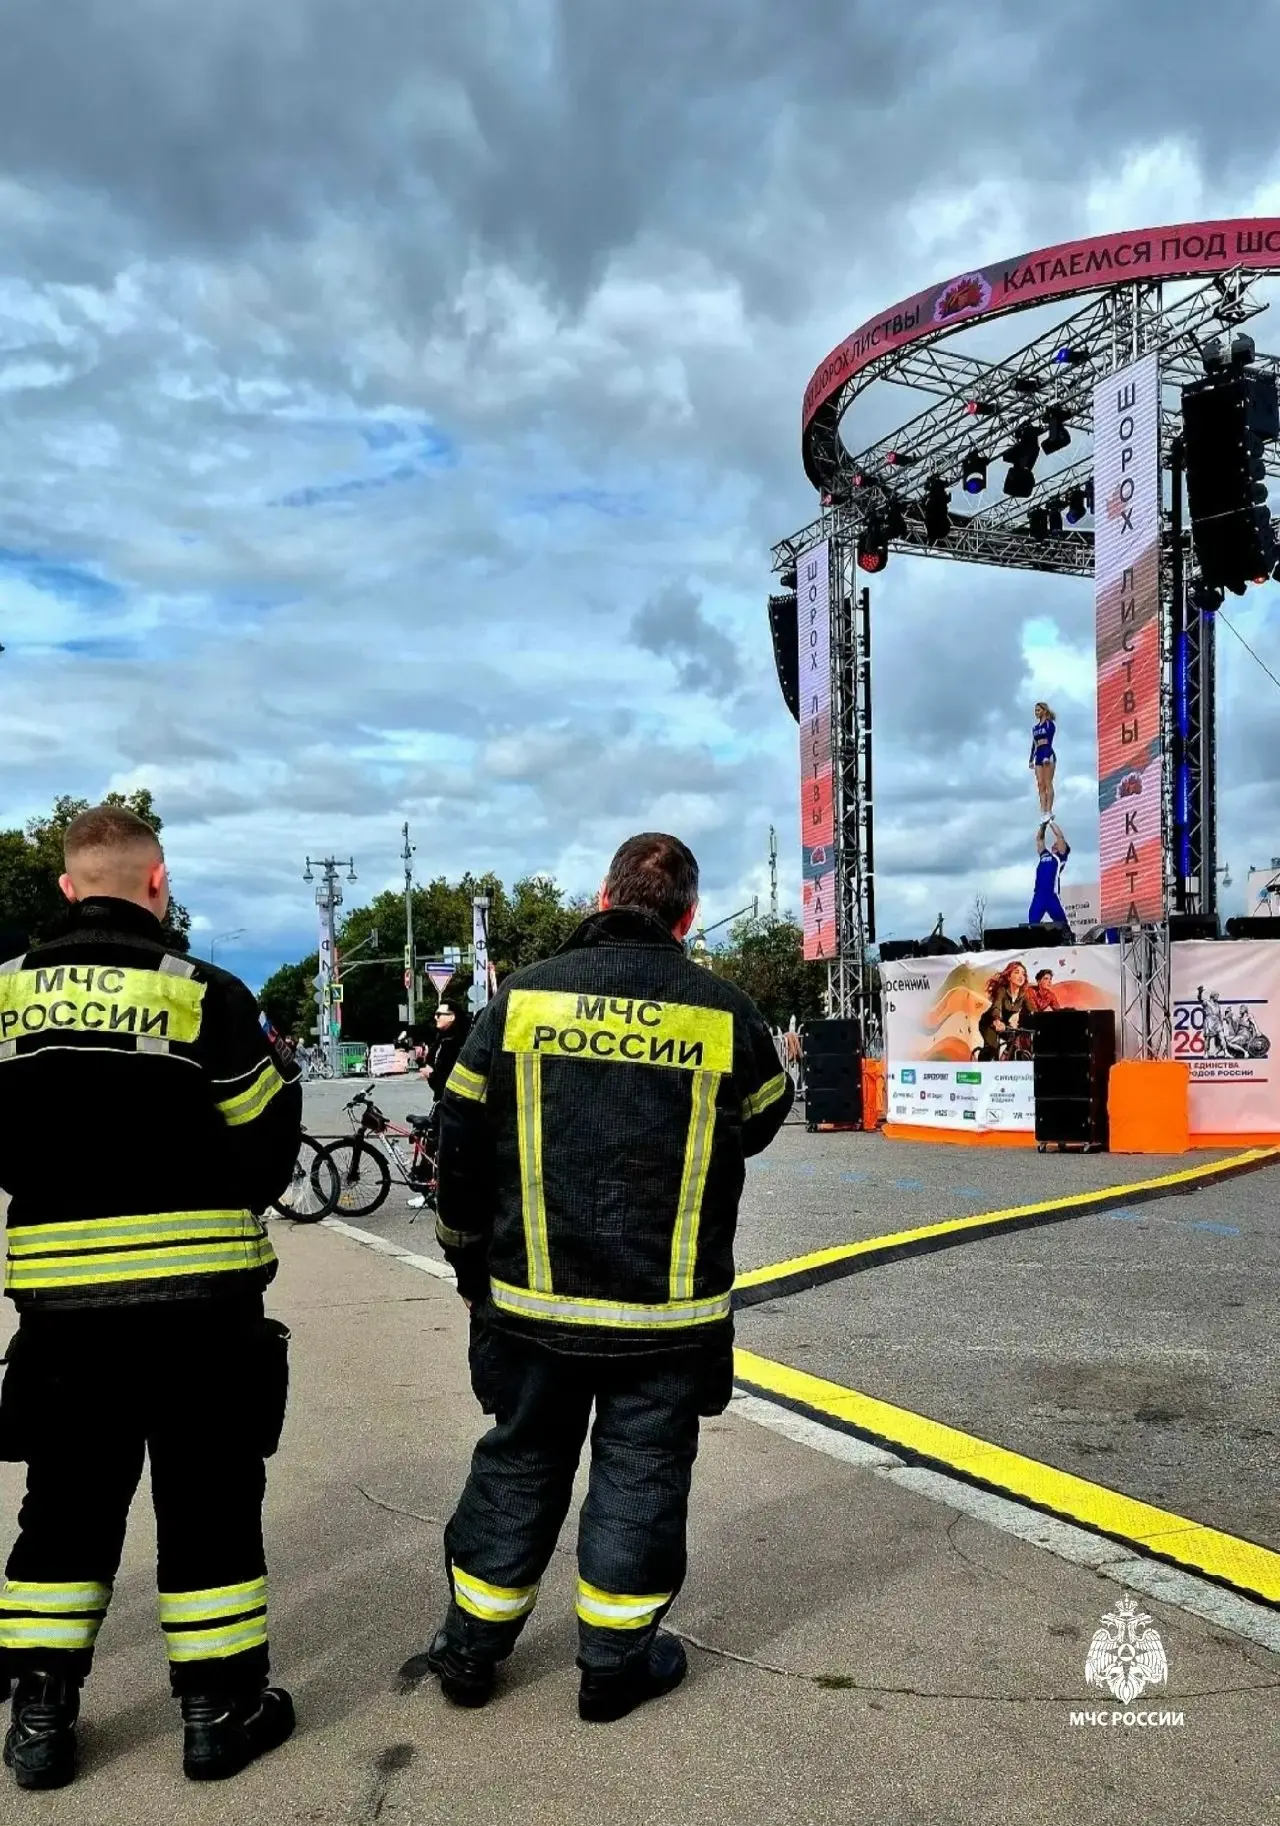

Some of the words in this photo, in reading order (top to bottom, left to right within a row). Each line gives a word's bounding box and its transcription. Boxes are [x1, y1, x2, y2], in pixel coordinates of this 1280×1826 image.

[1003, 240, 1151, 294] КАТАЕМСЯ
[1161, 232, 1225, 261] ПОД
[850, 304, 920, 363] ЛИСТВЫ
[1117, 382, 1136, 535] ШОРОХ
[808, 560, 818, 670] ШОРОХ
[1120, 567, 1138, 745] ЛИСТВЫ
[811, 695, 822, 825] ЛИСТВЫ
[35, 967, 126, 994] МЧС
[0, 1000, 169, 1038] РОССИИ
[575, 995, 663, 1027] МЧС
[1173, 1008, 1206, 1031] 20
[532, 1025, 704, 1067] РОССИИ
[1173, 1031, 1206, 1053] 26
[1194, 1062, 1239, 1070] ЕДИНСТВА
